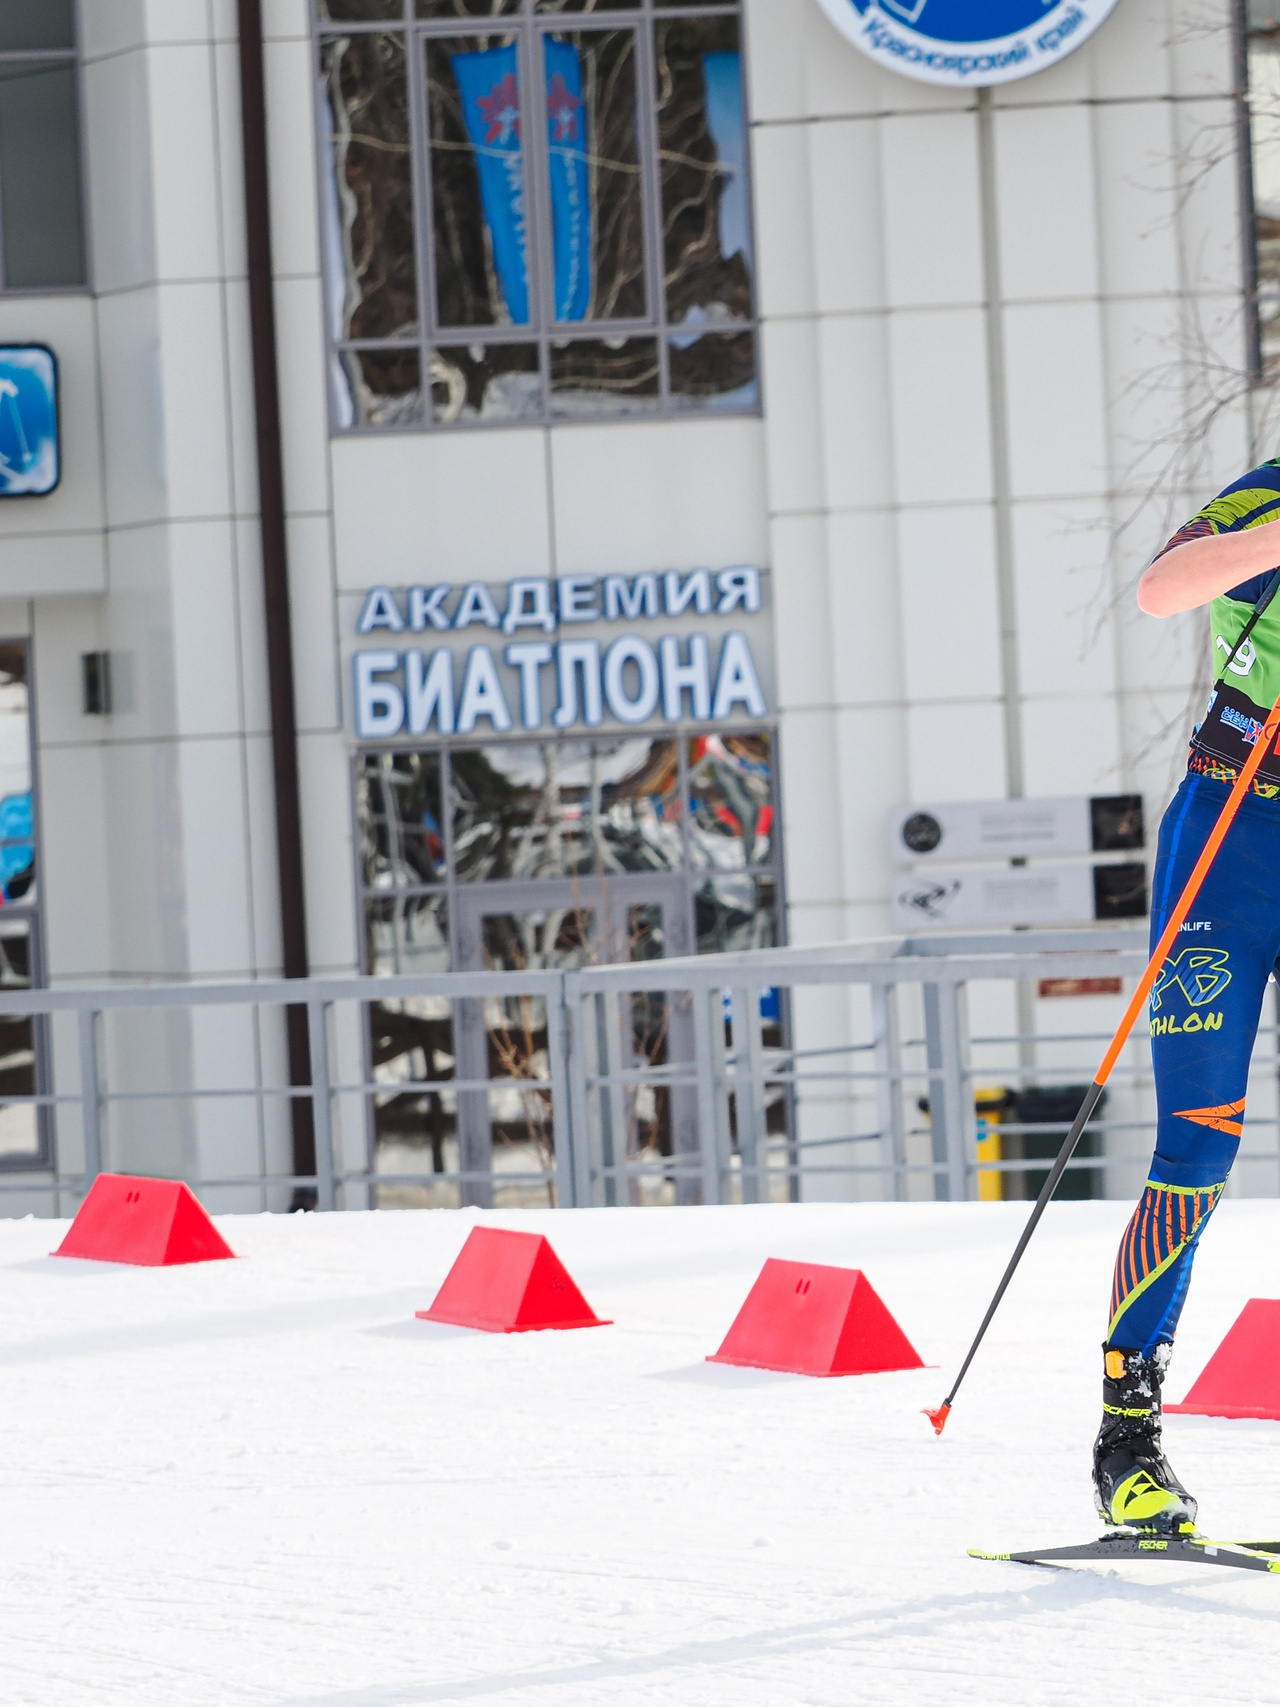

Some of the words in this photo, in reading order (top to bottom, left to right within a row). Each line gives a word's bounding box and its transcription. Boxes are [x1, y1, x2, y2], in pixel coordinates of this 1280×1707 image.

[357, 564, 763, 635] АКАДЕМИЯ
[352, 629, 769, 740] БИАТЛОНА
[1178, 921, 1212, 932] NLIFE
[1150, 1012, 1224, 1038] THLON
[1103, 1402, 1153, 1417] SCHER
[1138, 1541, 1168, 1550] FISCHER
